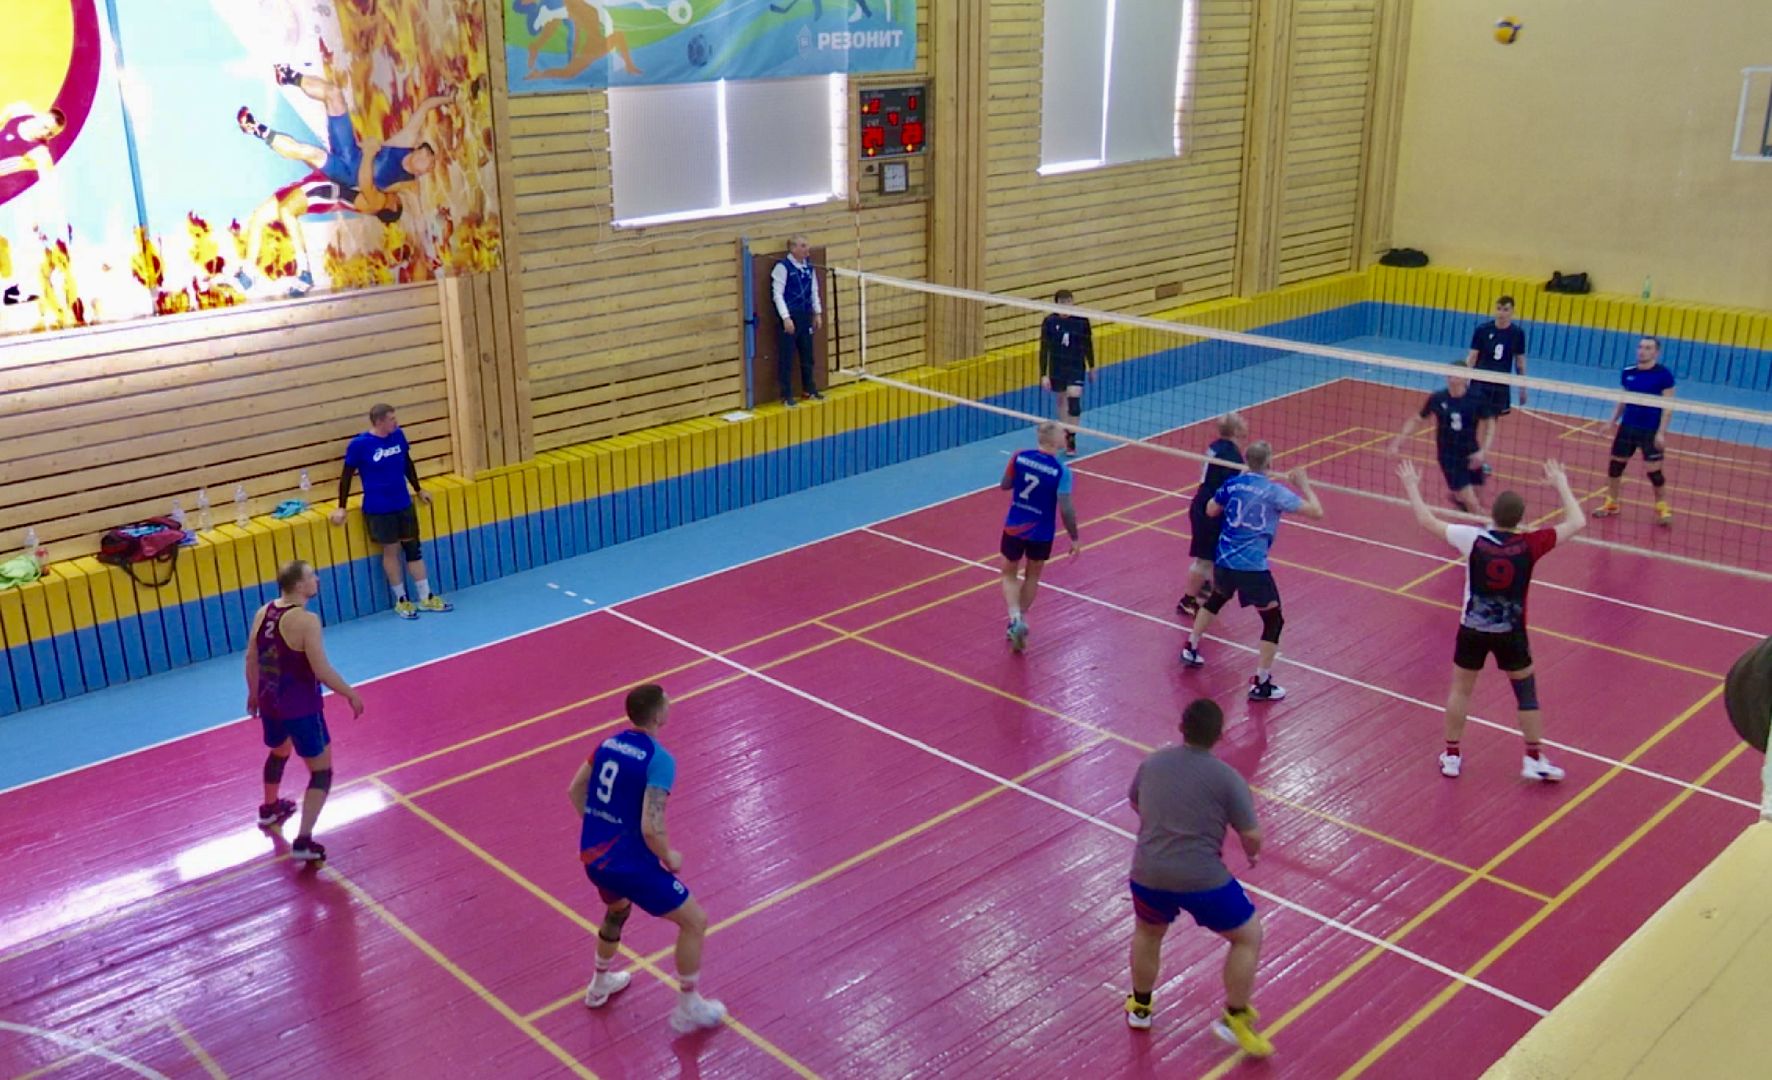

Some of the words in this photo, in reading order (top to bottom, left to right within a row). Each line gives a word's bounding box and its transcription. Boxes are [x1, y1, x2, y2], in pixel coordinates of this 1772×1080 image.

[817, 29, 904, 51] РЕЗОНИТ
[1019, 472, 1040, 500] 7
[1486, 558, 1515, 590] 9
[264, 620, 276, 639] 2
[596, 759, 620, 804] 9
[672, 880, 685, 895] 9
